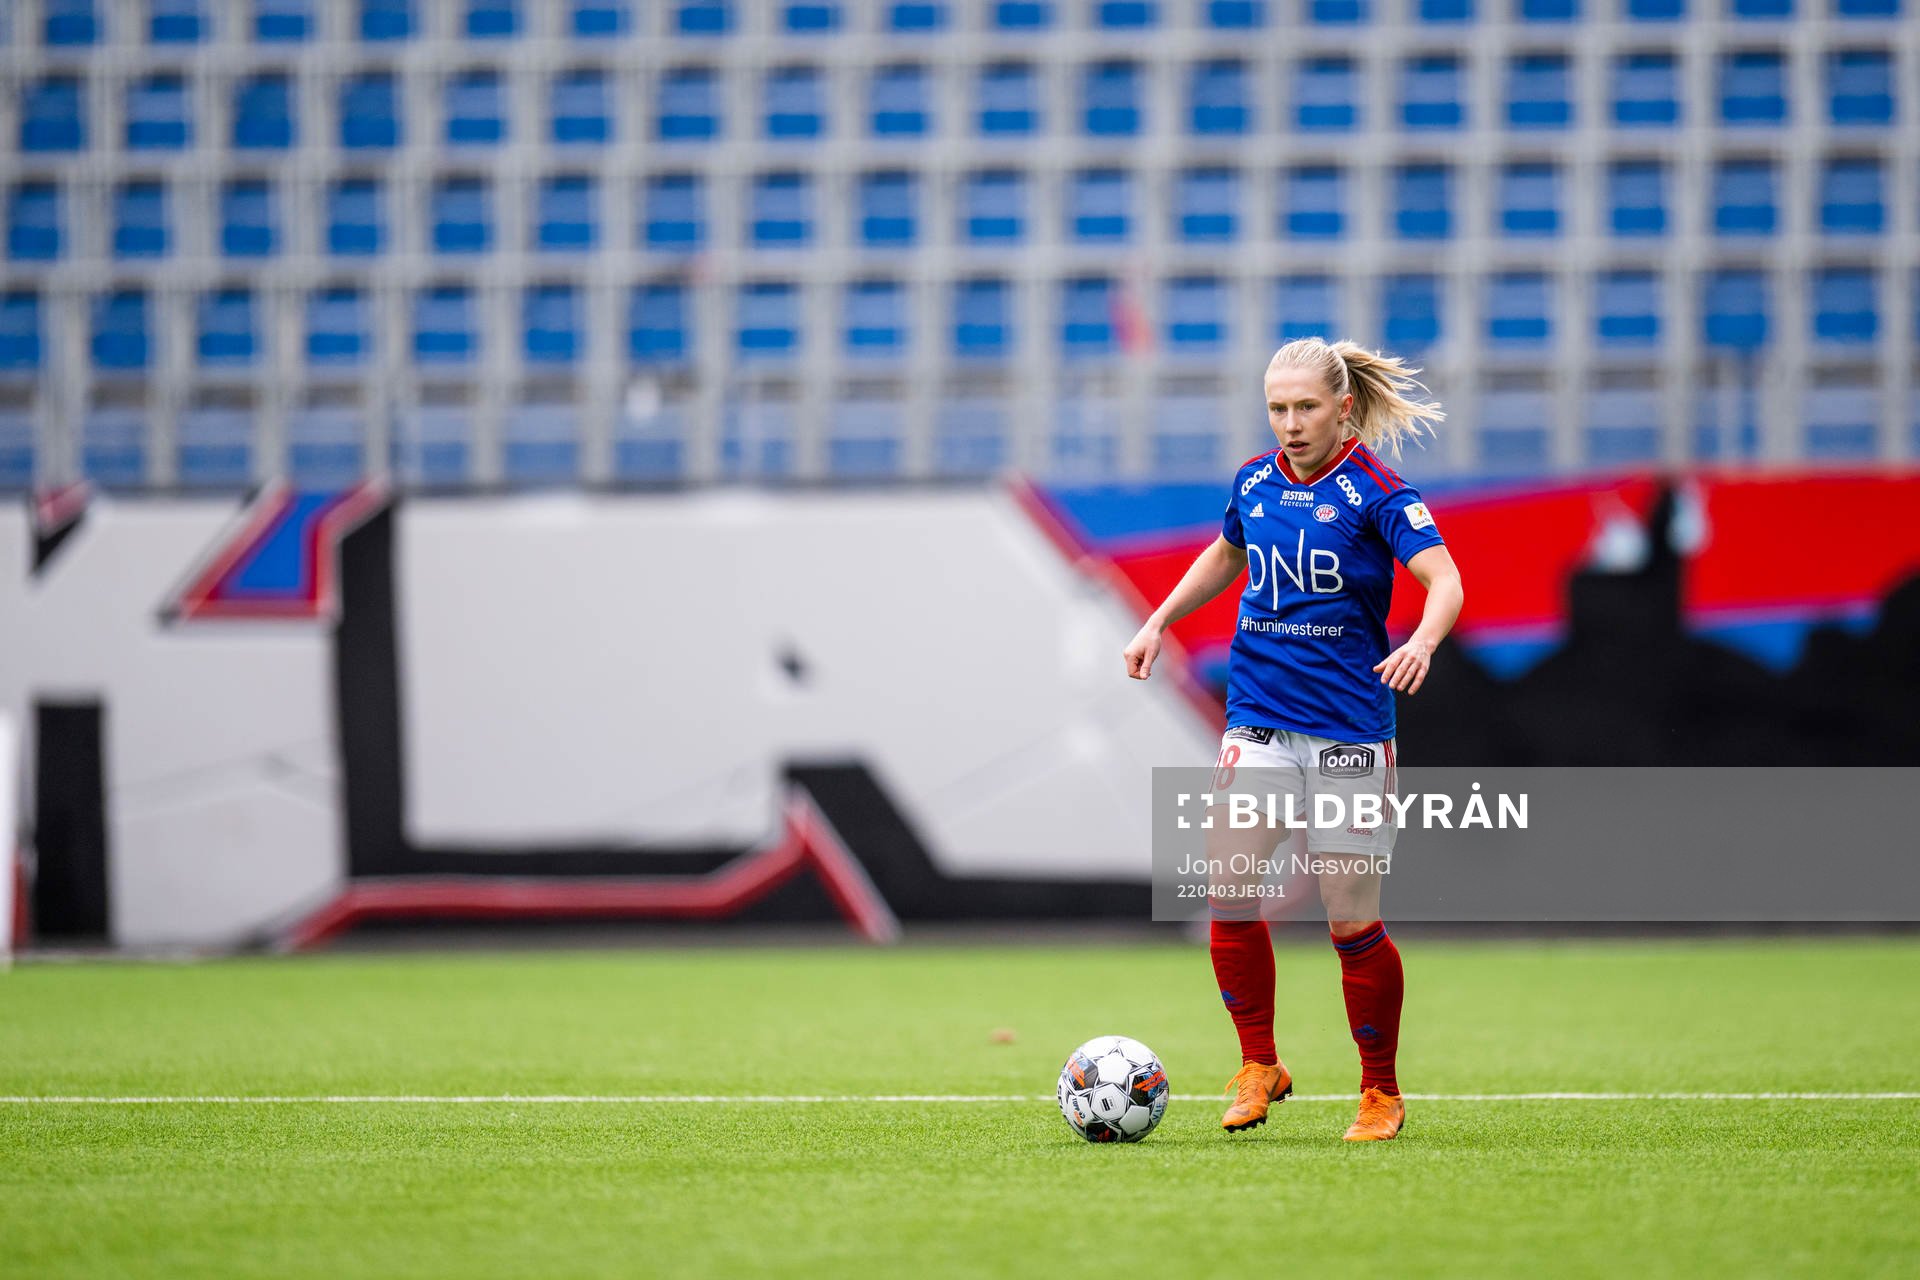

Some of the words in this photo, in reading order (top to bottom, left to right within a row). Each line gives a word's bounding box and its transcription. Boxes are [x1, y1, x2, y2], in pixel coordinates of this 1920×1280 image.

[1241, 464, 1273, 496] coop
[1335, 474, 1363, 506] coop
[1289, 491, 1314, 501] STENA
[1247, 529, 1344, 611] DNB
[1240, 616, 1344, 637] #huninvesterer
[1326, 752, 1368, 768] ooni
